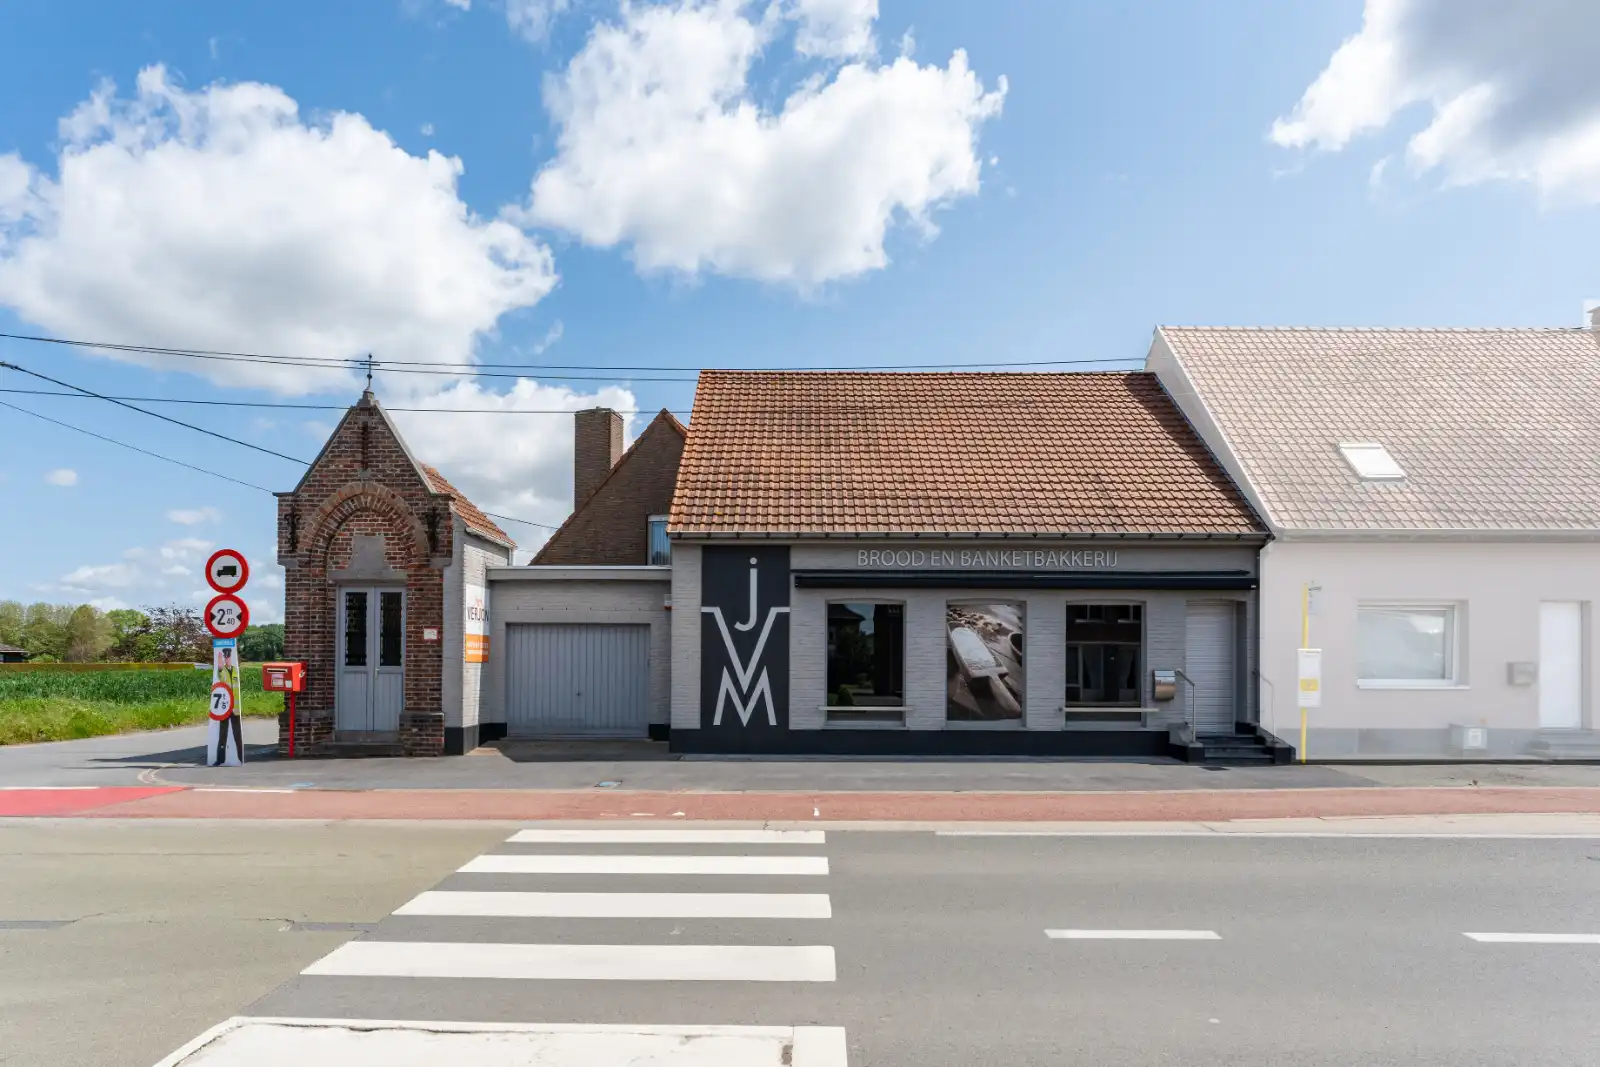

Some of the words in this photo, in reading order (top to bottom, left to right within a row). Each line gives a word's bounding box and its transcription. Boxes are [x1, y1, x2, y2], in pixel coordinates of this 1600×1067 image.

[857, 550, 925, 566] BROOD
[930, 550, 954, 566] EN
[960, 550, 1118, 567] BANKETBAKKERIJ
[217, 608, 226, 625] 2
[213, 693, 222, 709] 7
